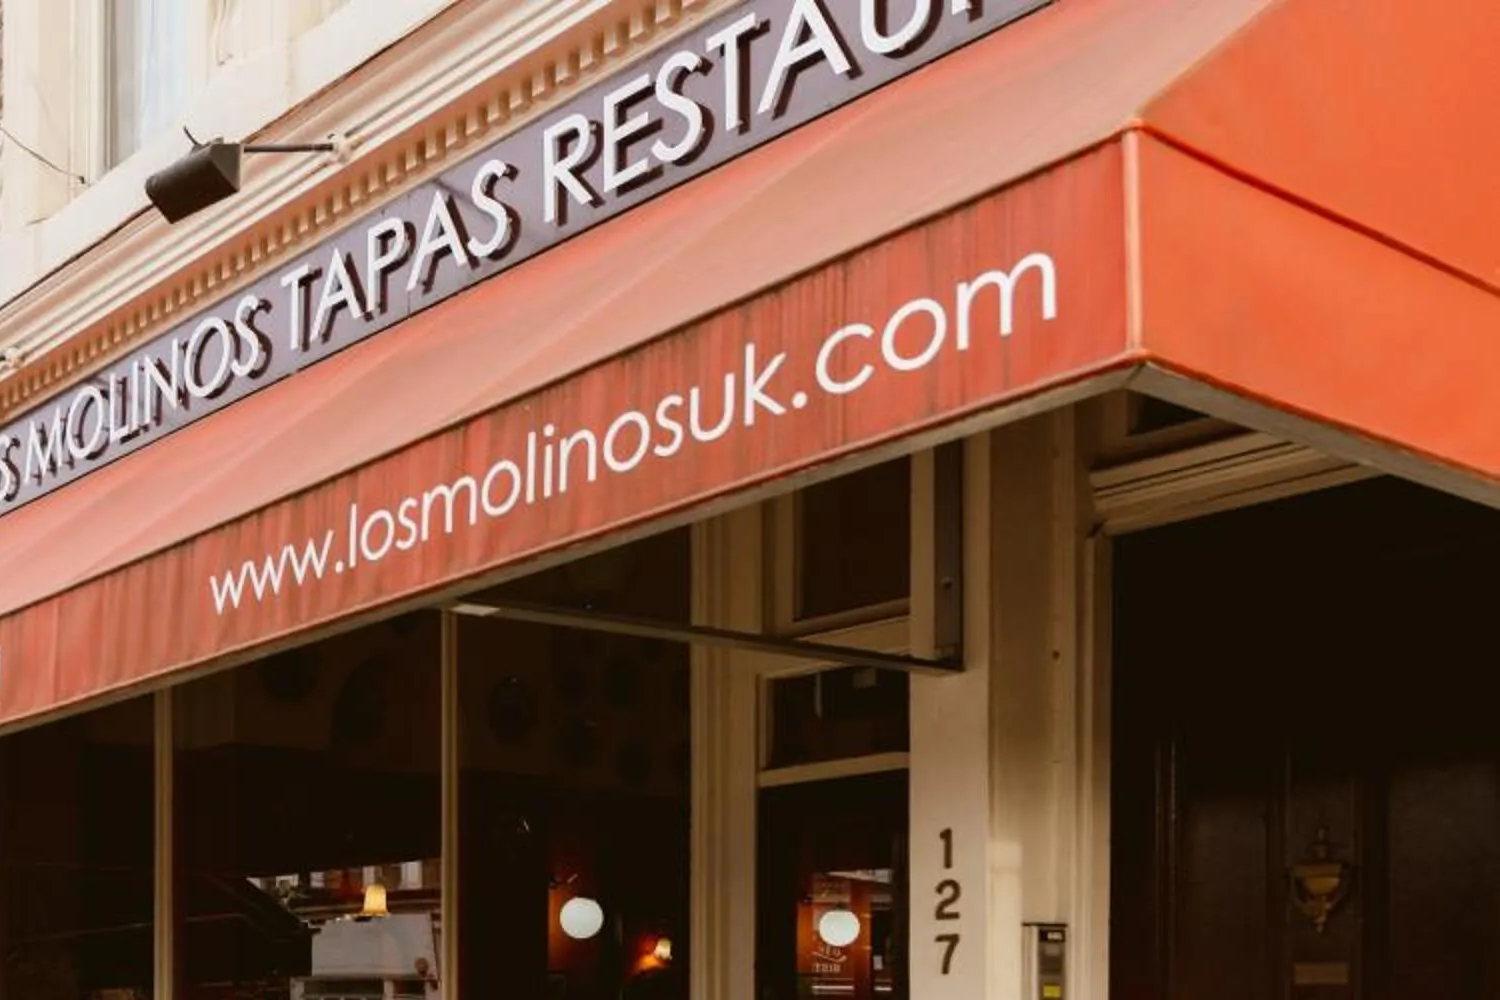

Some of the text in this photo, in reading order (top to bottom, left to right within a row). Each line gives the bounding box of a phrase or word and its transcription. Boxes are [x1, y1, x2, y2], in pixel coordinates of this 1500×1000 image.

[22, 293, 261, 485] MOLINOS
[280, 159, 514, 351] TAPAS
[541, 0, 971, 224] RESTAU
[208, 250, 1059, 614] www.losmolinosuk.com
